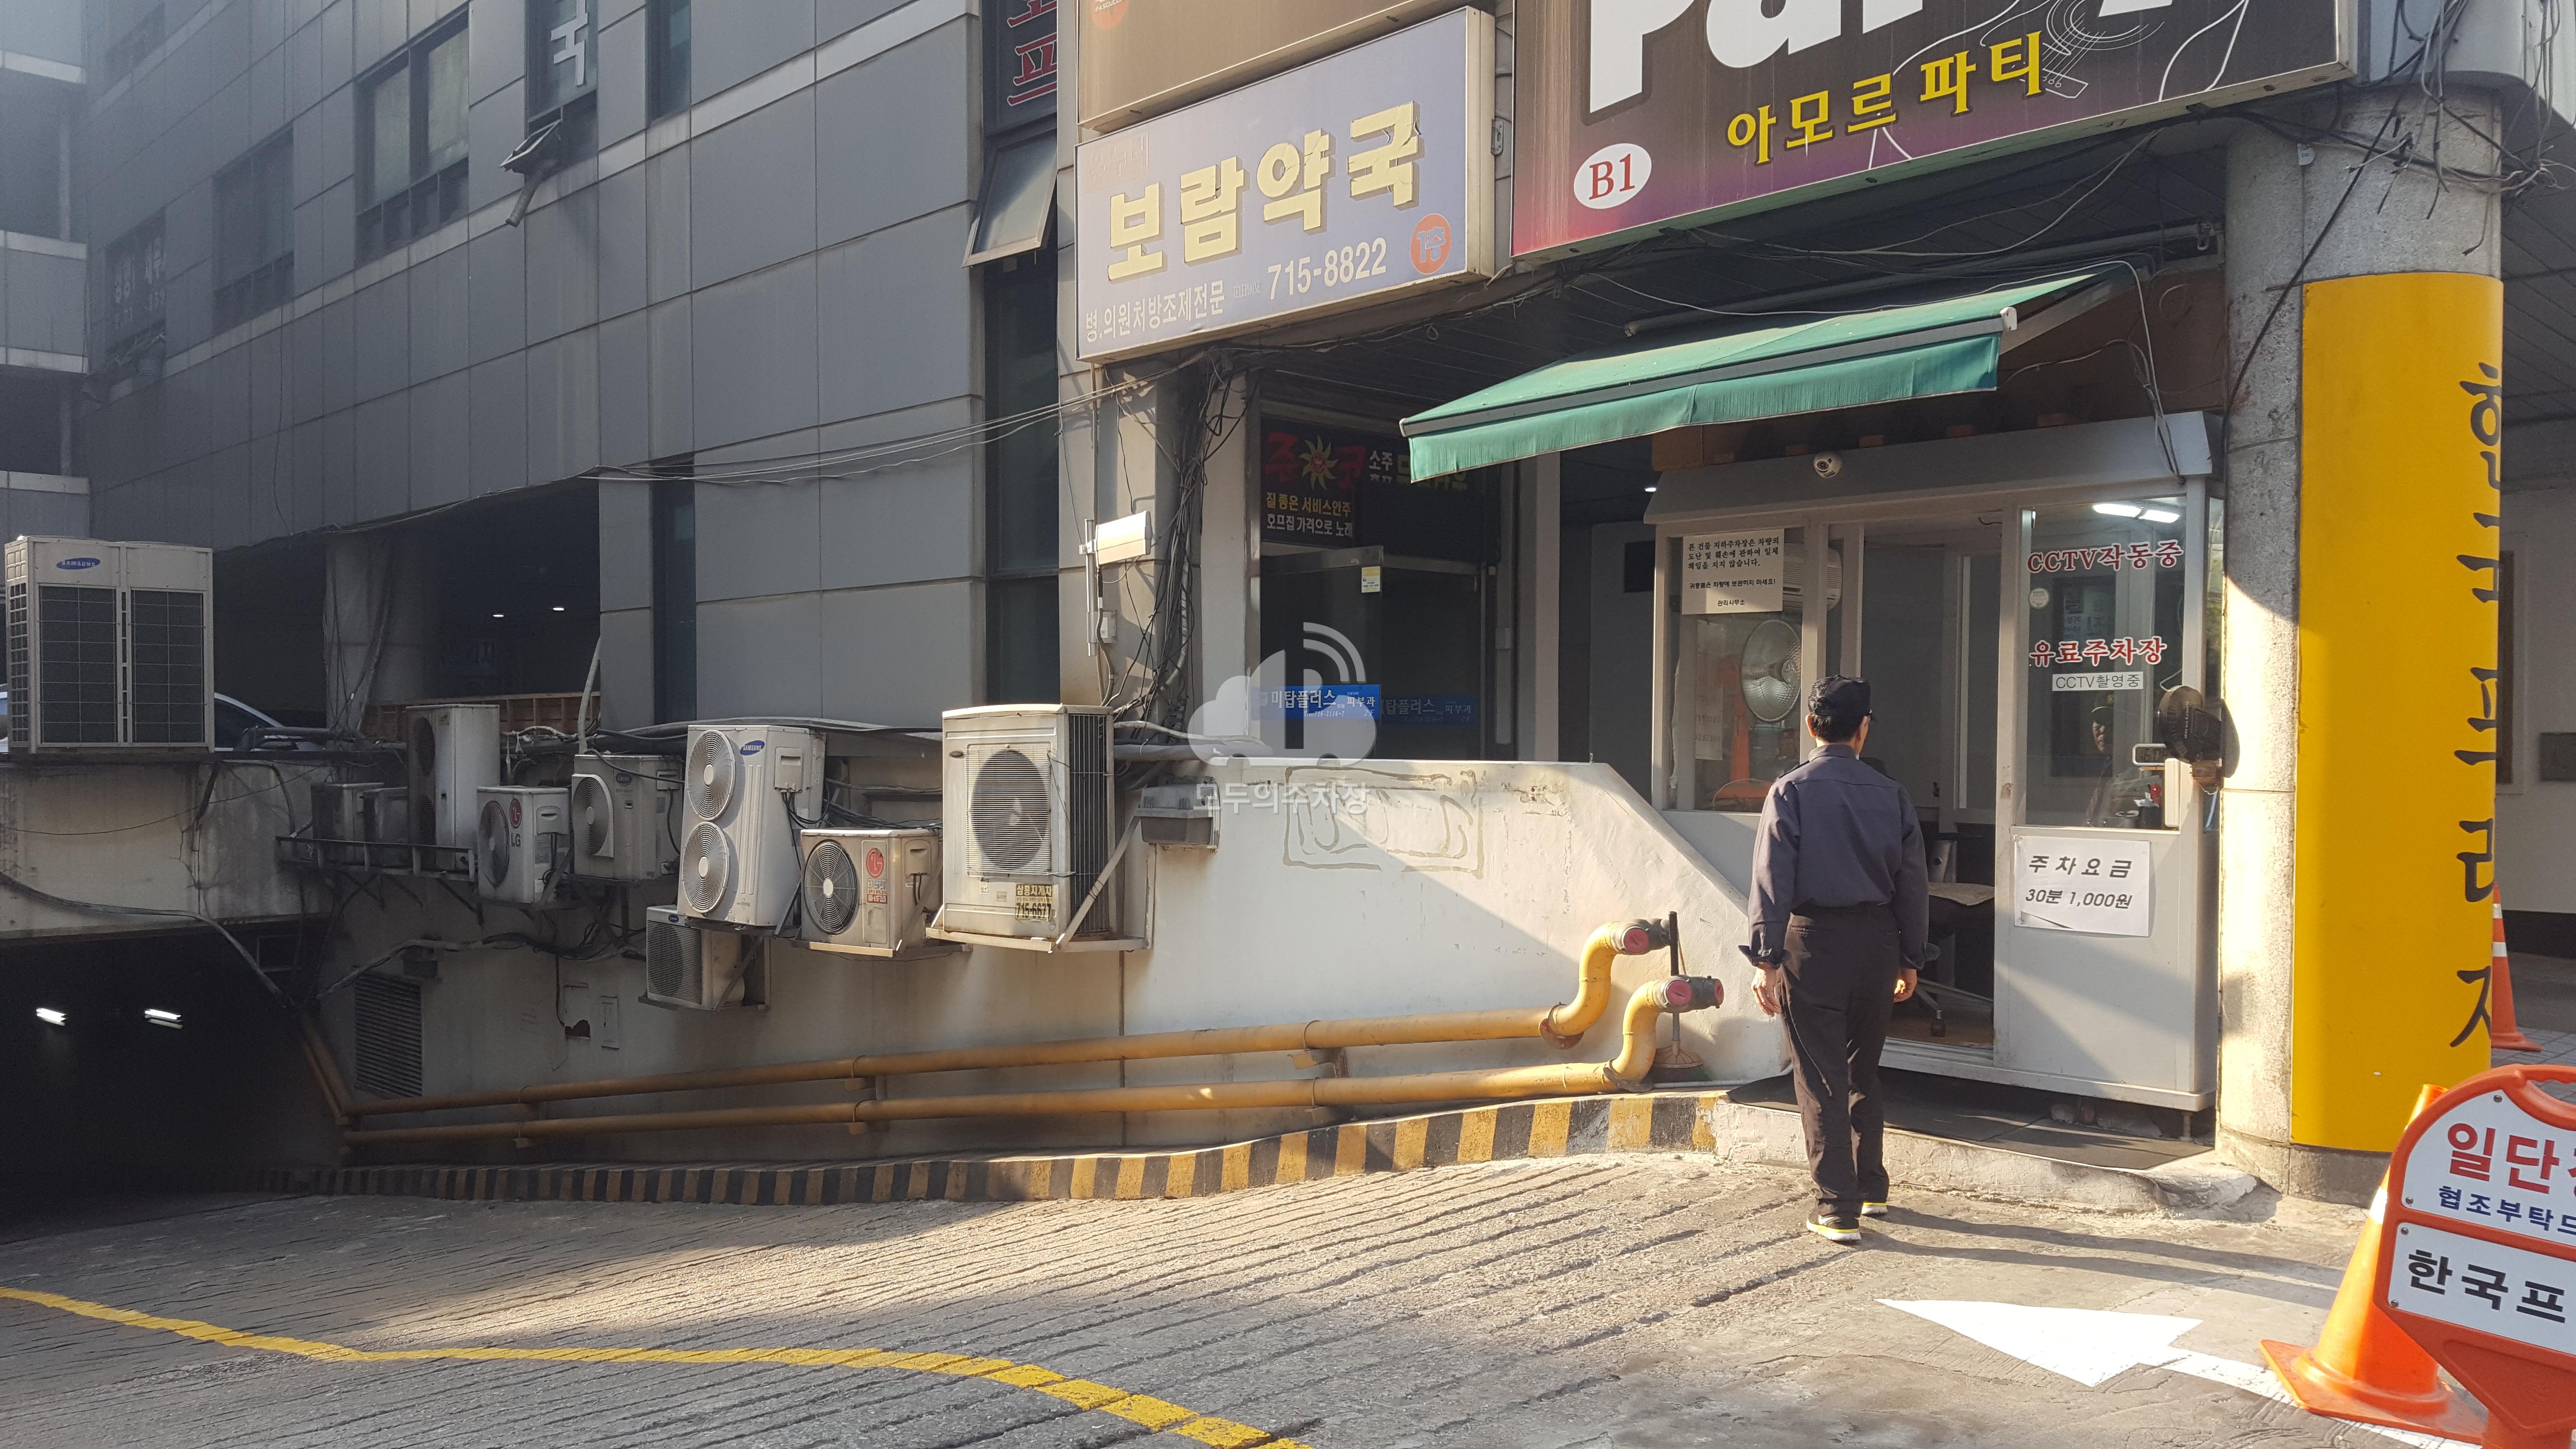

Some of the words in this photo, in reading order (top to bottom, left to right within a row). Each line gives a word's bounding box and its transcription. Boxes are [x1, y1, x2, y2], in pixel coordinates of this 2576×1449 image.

[1588, 153, 1636, 201] B1
[1108, 101, 1420, 282] 보람약국
[1233, 281, 1261, 299] TELEPHONE
[1268, 237, 1386, 300] 715-8822
[1369, 450, 1393, 471] 소주
[1302, 497, 1351, 517] 서비스안주
[2029, 635, 2167, 667] 유료주차장
[1346, 696, 1376, 708] 피부과
[1383, 698, 1435, 715] 탑플러스
[511, 833, 521, 847] LG
[2025, 888, 2063, 904] 30분
[2069, 891, 2133, 909] 1,000원
[2447, 1123, 2576, 1194] 일단
